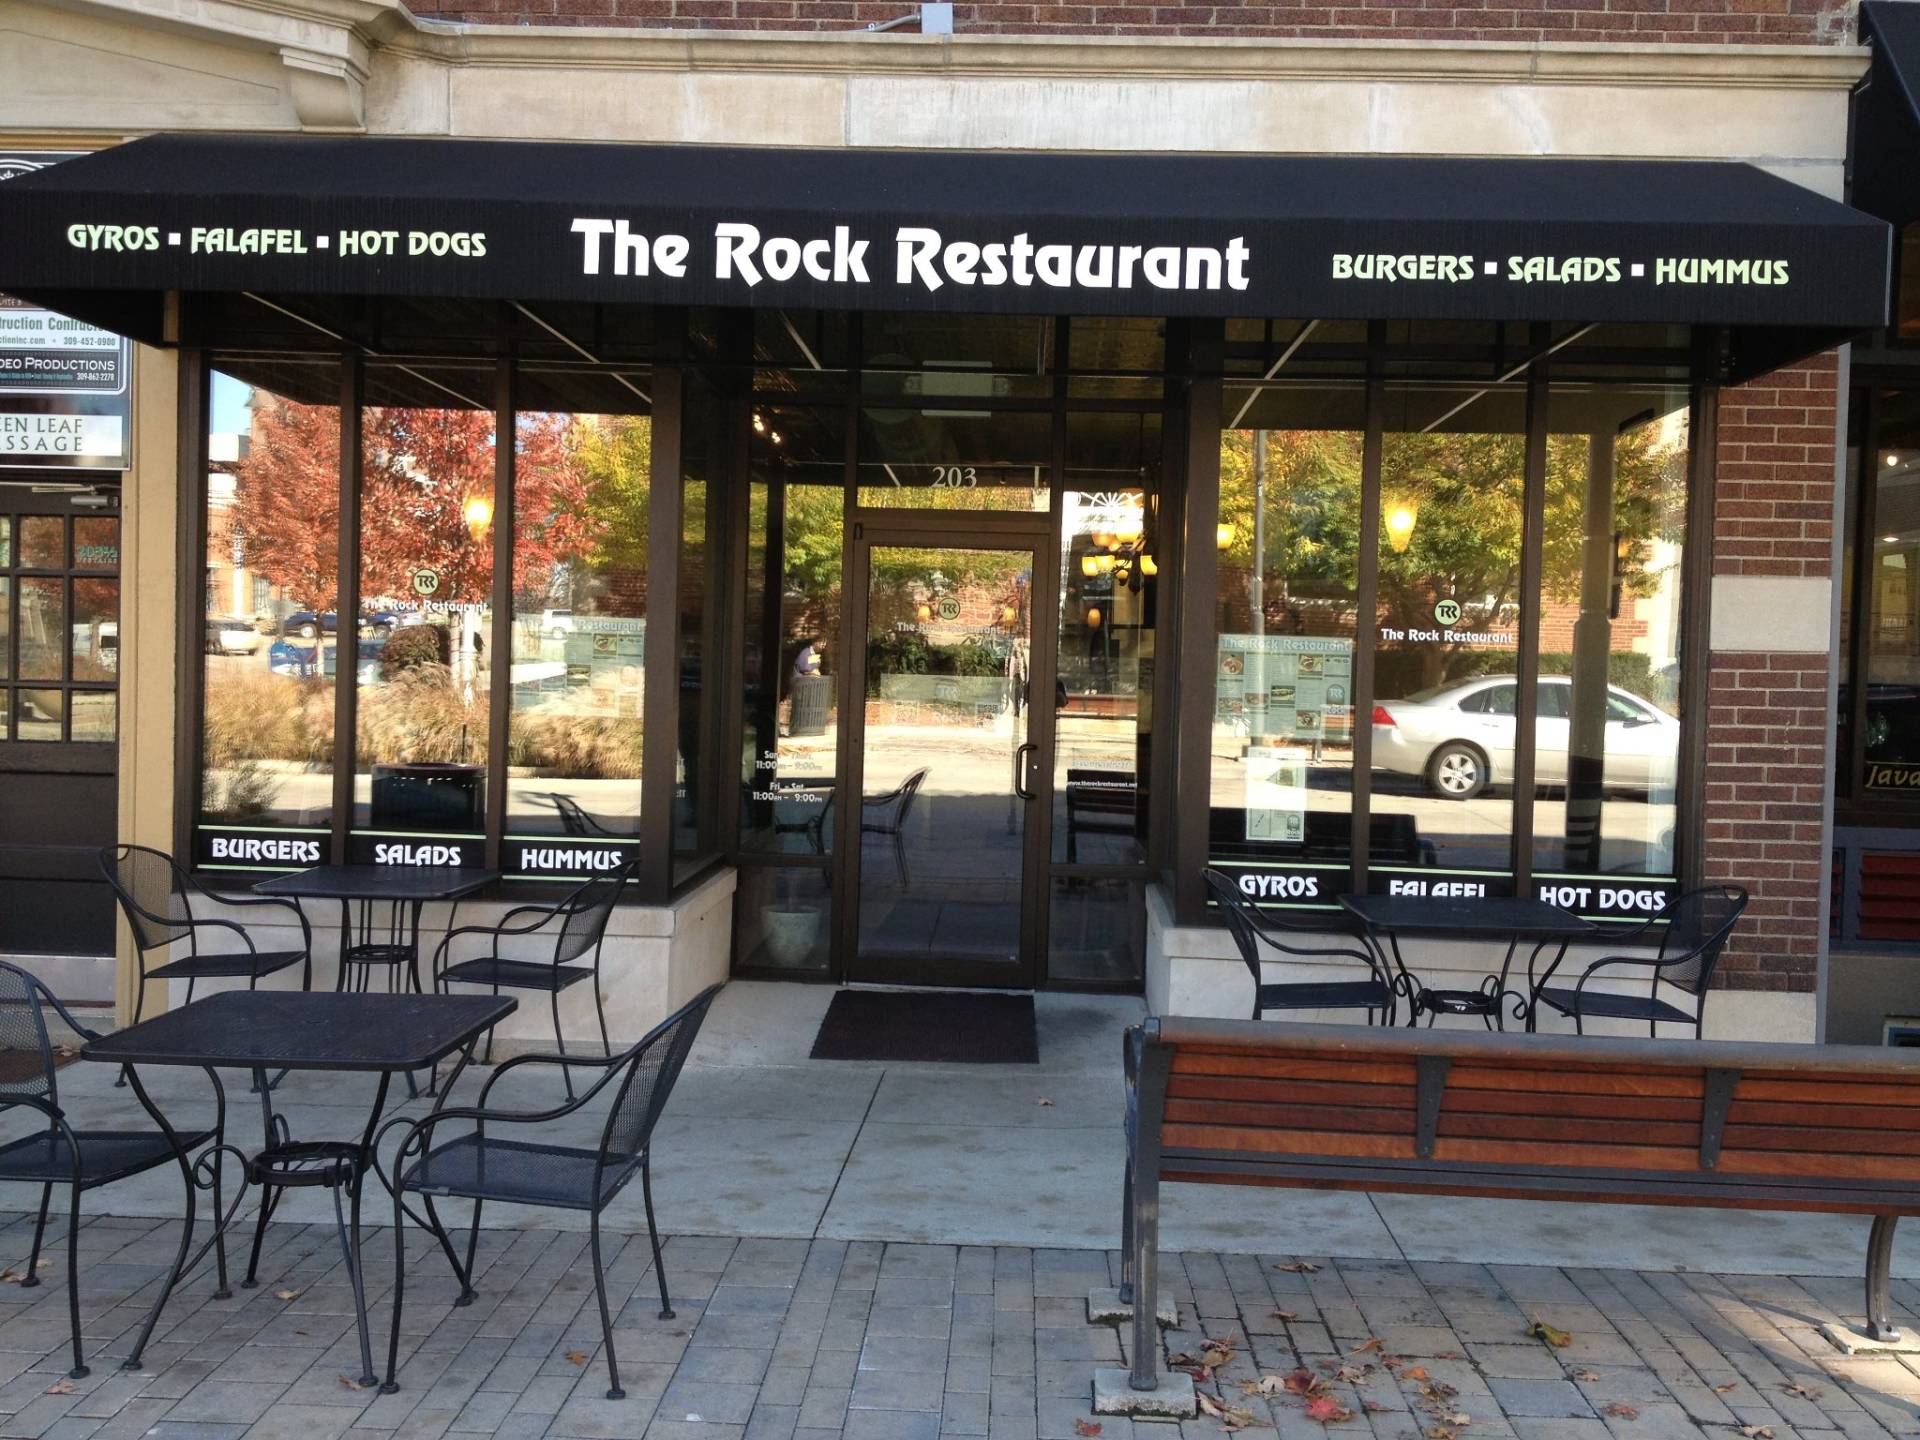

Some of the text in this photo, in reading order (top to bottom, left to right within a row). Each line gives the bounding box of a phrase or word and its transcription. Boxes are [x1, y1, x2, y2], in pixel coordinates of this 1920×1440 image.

[67, 223, 488, 259] GYROS FALAFEL HOT DOGS
[570, 217, 1250, 293] The Rock Restaurant
[1332, 253, 1791, 287] BURGERS SALADS HUMMUS
[25, 357, 116, 371] PRODUCTIONS
[0, 417, 83, 433] EN LEAF
[0, 435, 83, 451] SSAGE
[930, 466, 977, 488] 203
[389, 599, 418, 612] Rock
[423, 599, 488, 613] Restaurant
[1223, 638, 1349, 652] The Rock Restaurant
[1381, 628, 1512, 643] The Rock Restaurant
[211, 837, 321, 863] BURGERS
[375, 843, 462, 867] SALADS
[521, 848, 623, 871] HUMMUS
[1238, 874, 1319, 899] GYROS
[1389, 879, 1486, 898] FALAFEL
[1539, 886, 1667, 912] HOT DOGS
